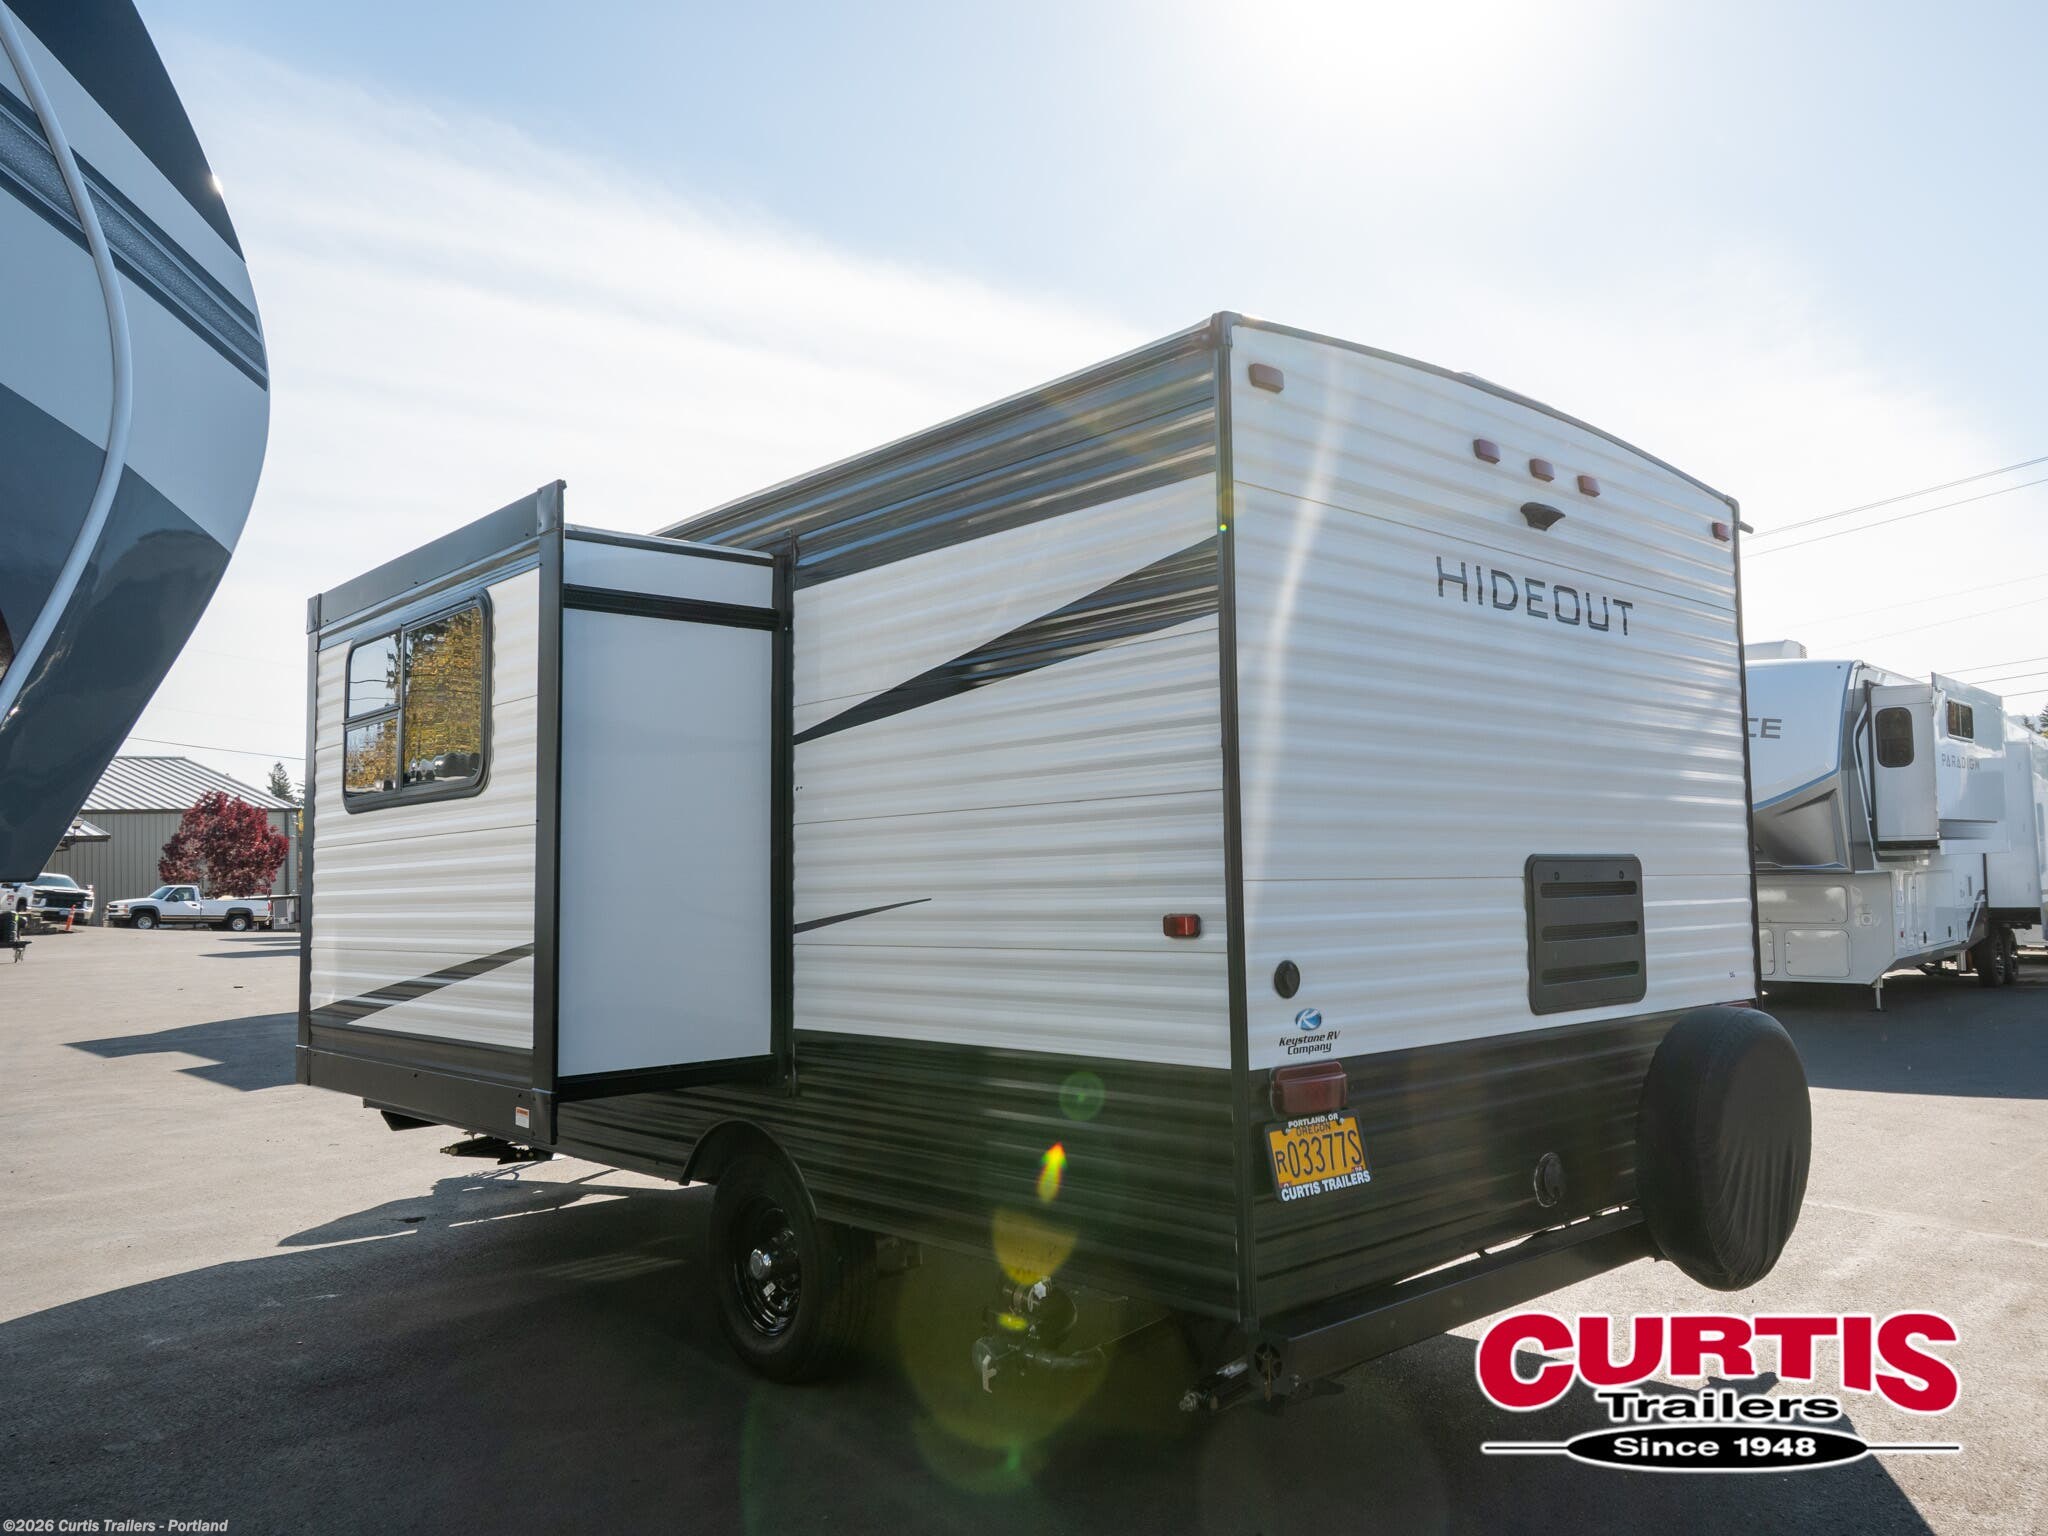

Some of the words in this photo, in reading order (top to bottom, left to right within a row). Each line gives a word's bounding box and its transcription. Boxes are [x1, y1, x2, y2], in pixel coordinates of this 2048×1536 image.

[1436, 556, 1633, 636] HIDEOUT
[1279, 1034, 1326, 1047] Keystone
[1326, 1030, 1341, 1041] RV
[1287, 1043, 1332, 1055] Company
[1328, 1112, 1339, 1121] OR
[1275, 1130, 1363, 1178] R03377S
[1281, 1181, 1321, 1202] CURTIS
[1322, 1170, 1371, 1192] TRAILERS
